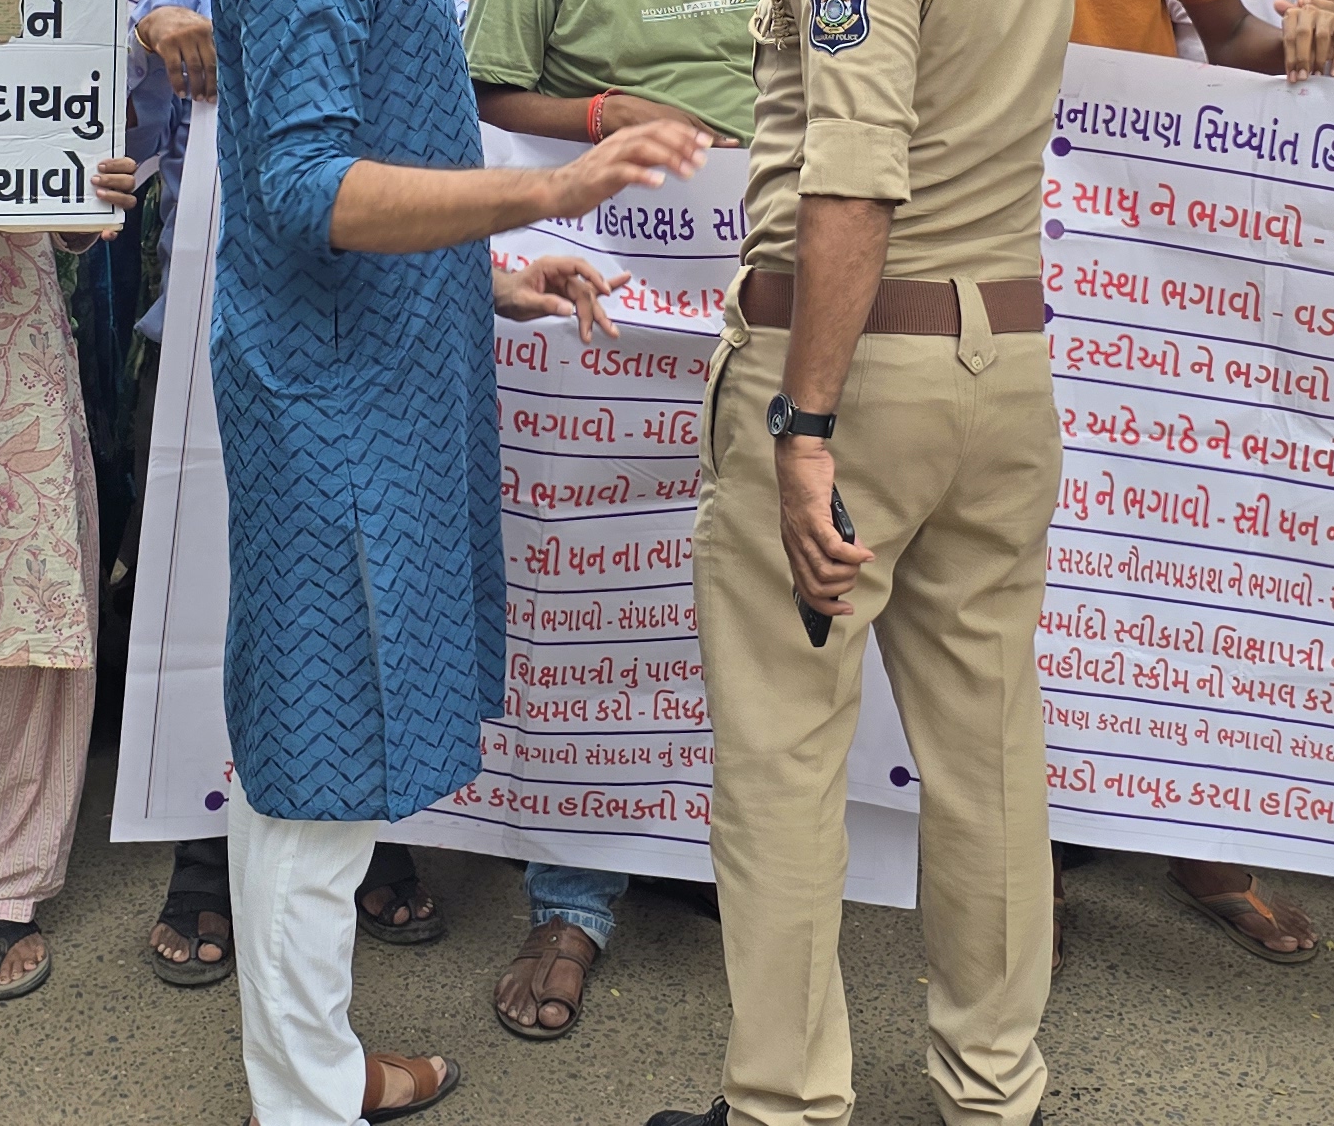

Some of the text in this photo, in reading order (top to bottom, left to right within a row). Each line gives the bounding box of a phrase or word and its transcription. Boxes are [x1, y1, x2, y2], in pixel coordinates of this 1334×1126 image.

[641, 5, 682, 15] MOVING
[581, 347, 678, 378] વડતાલ
[513, 408, 616, 444] ભગાવો
[530, 475, 629, 509] ભગાવો
[1095, 471, 1115, 516] ને
[1123, 484, 1211, 530] ભગાવો
[1233, 493, 1271, 538] સ્ત્રી
[1278, 508, 1319, 547] ધન
[568, 544, 605, 576] ધન
[612, 542, 640, 572] ના
[1057, 547, 1114, 578] સરદાર
[1117, 545, 1224, 594] નૌતમપ્રકાશ
[1227, 562, 1244, 598] ને
[1248, 572, 1313, 608] ભગાવો
[541, 600, 678, 632] ભગાવો સંપ્રદાય
[1037, 604, 1107, 641] ધર્માદો
[1114, 615, 1204, 654] સ્વીકારો
[1212, 625, 1325, 673] શિક્ષાપત્રી
[510, 653, 638, 689] શિક્ષાપત્રી નું
[527, 696, 631, 723] અમલ કરો
[489, 785, 677, 821] કરવા હરિભક્તો
[1046, 760, 1096, 794] સડો
[1104, 773, 1181, 809] નાબૂદ
[1188, 782, 1251, 813] કરવા
